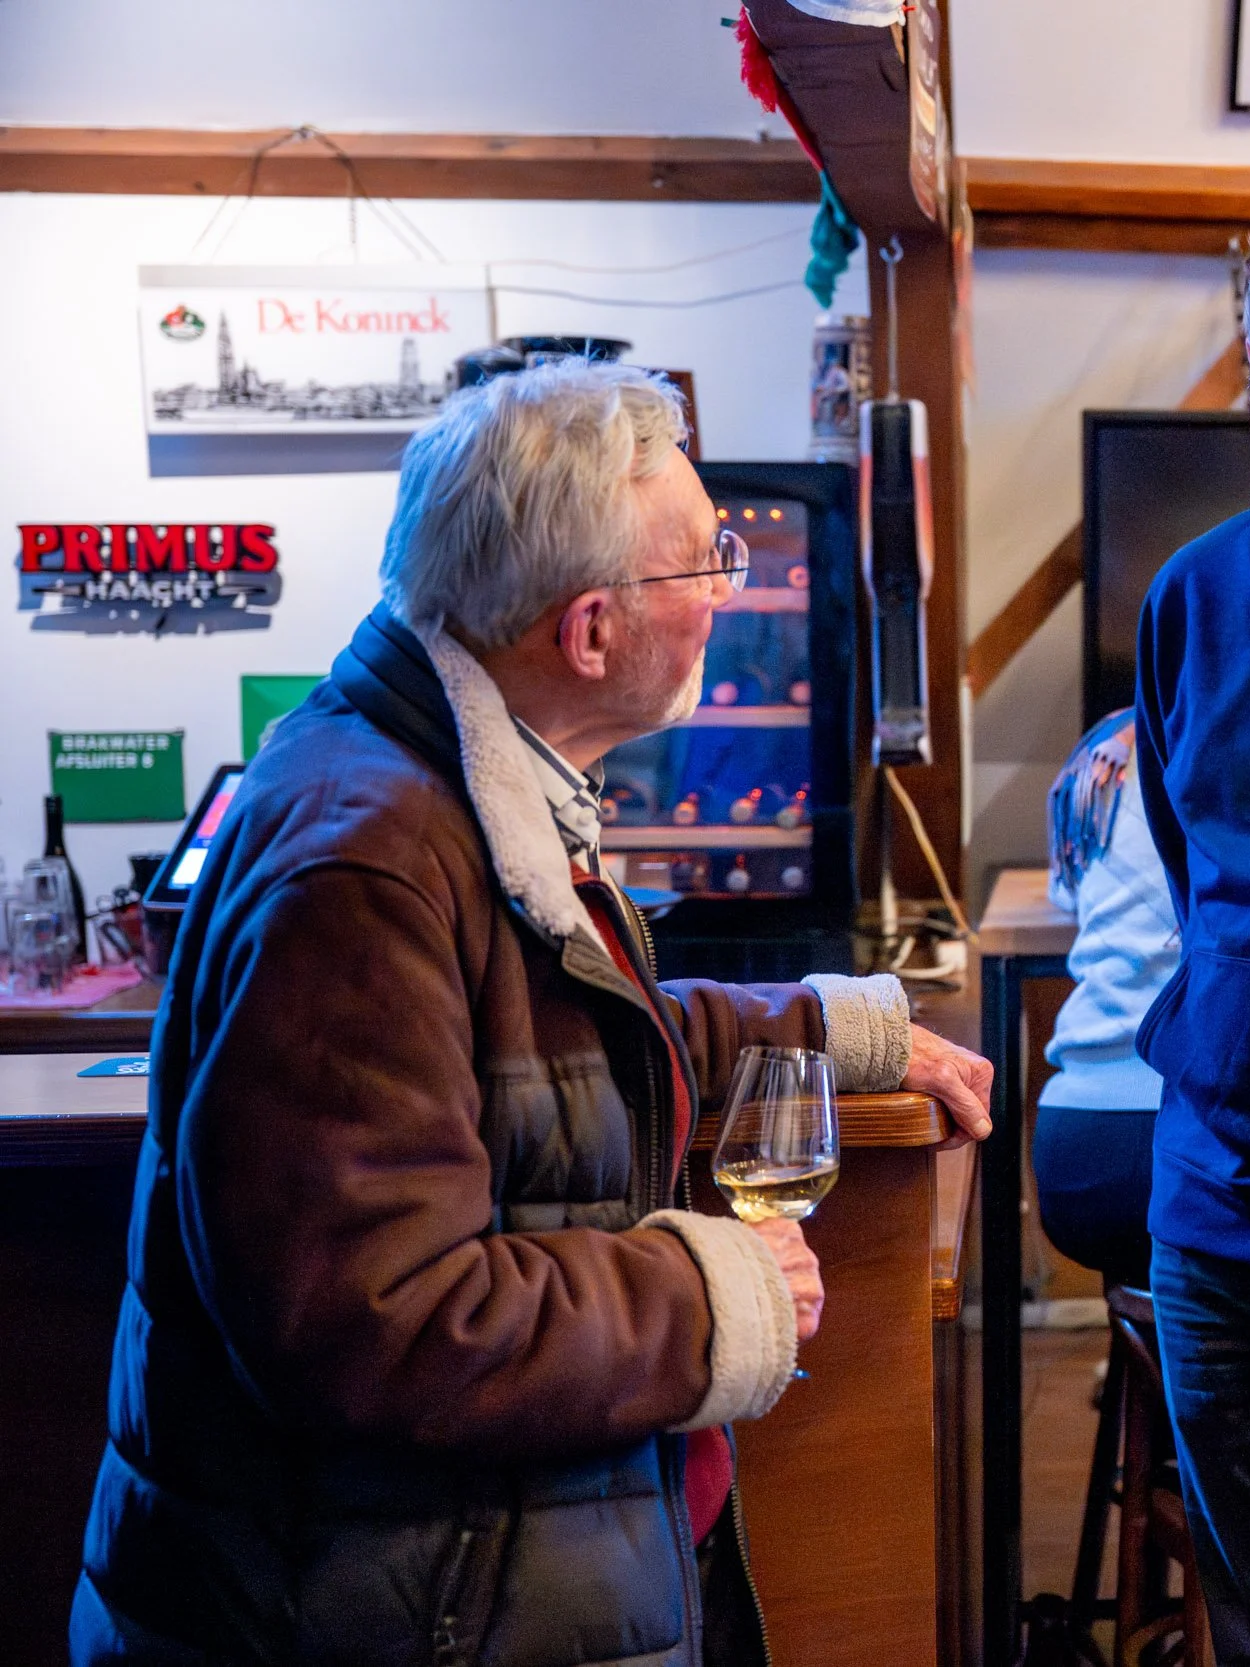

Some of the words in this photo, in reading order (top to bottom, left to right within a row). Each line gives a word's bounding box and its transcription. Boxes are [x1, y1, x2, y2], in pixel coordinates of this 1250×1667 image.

[258, 298, 306, 334] De
[316, 295, 450, 334] Koninck
[17, 522, 279, 573] PRIMUS
[86, 579, 215, 601] HAACHT
